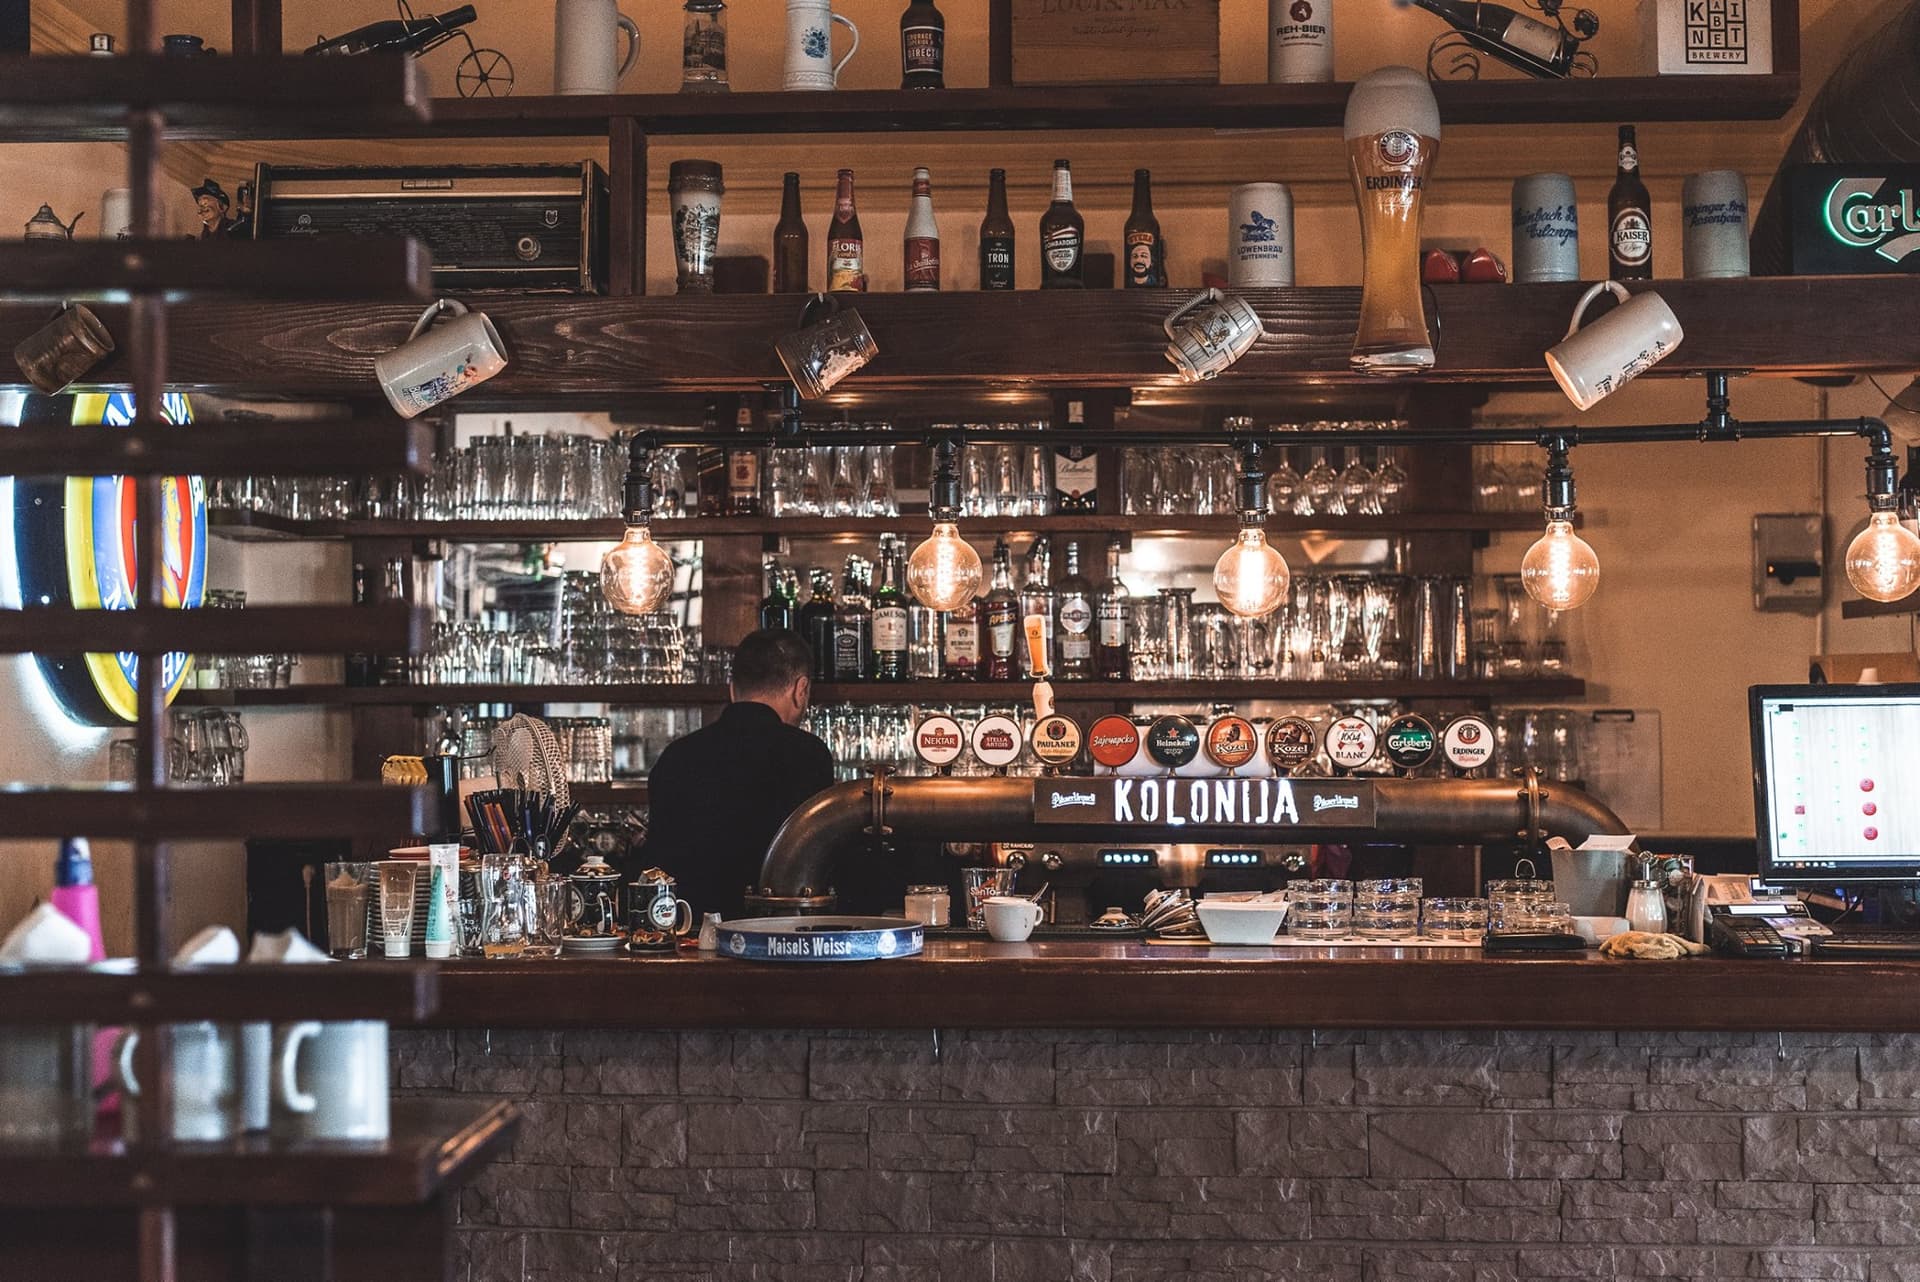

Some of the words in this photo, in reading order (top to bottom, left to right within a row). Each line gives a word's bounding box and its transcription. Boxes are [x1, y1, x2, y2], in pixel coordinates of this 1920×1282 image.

[1692, 52, 1741, 60] BREWERY
[1824, 178, 1920, 247] Carl
[1617, 231, 1648, 242] KAISER
[988, 253, 1009, 264] TRON
[875, 610, 906, 621] JAMESON
[1097, 608, 1129, 618] CAMPARI
[991, 613, 1017, 625] APEROL
[924, 736, 956, 746] NEKTAR
[1037, 741, 1077, 749] PAULANER
[1156, 739, 1190, 747] Heineken
[1388, 735, 1432, 751] Carlsberg
[1216, 743, 1249, 754] Kozel
[1273, 743, 1309, 755] Kozel
[1453, 747, 1486, 755] ERDINGER
[1336, 751, 1367, 760] BLANC
[1114, 779, 1300, 824] KOLONIJA
[767, 936, 810, 957] Maisel's
[813, 936, 852, 957] Weisse
